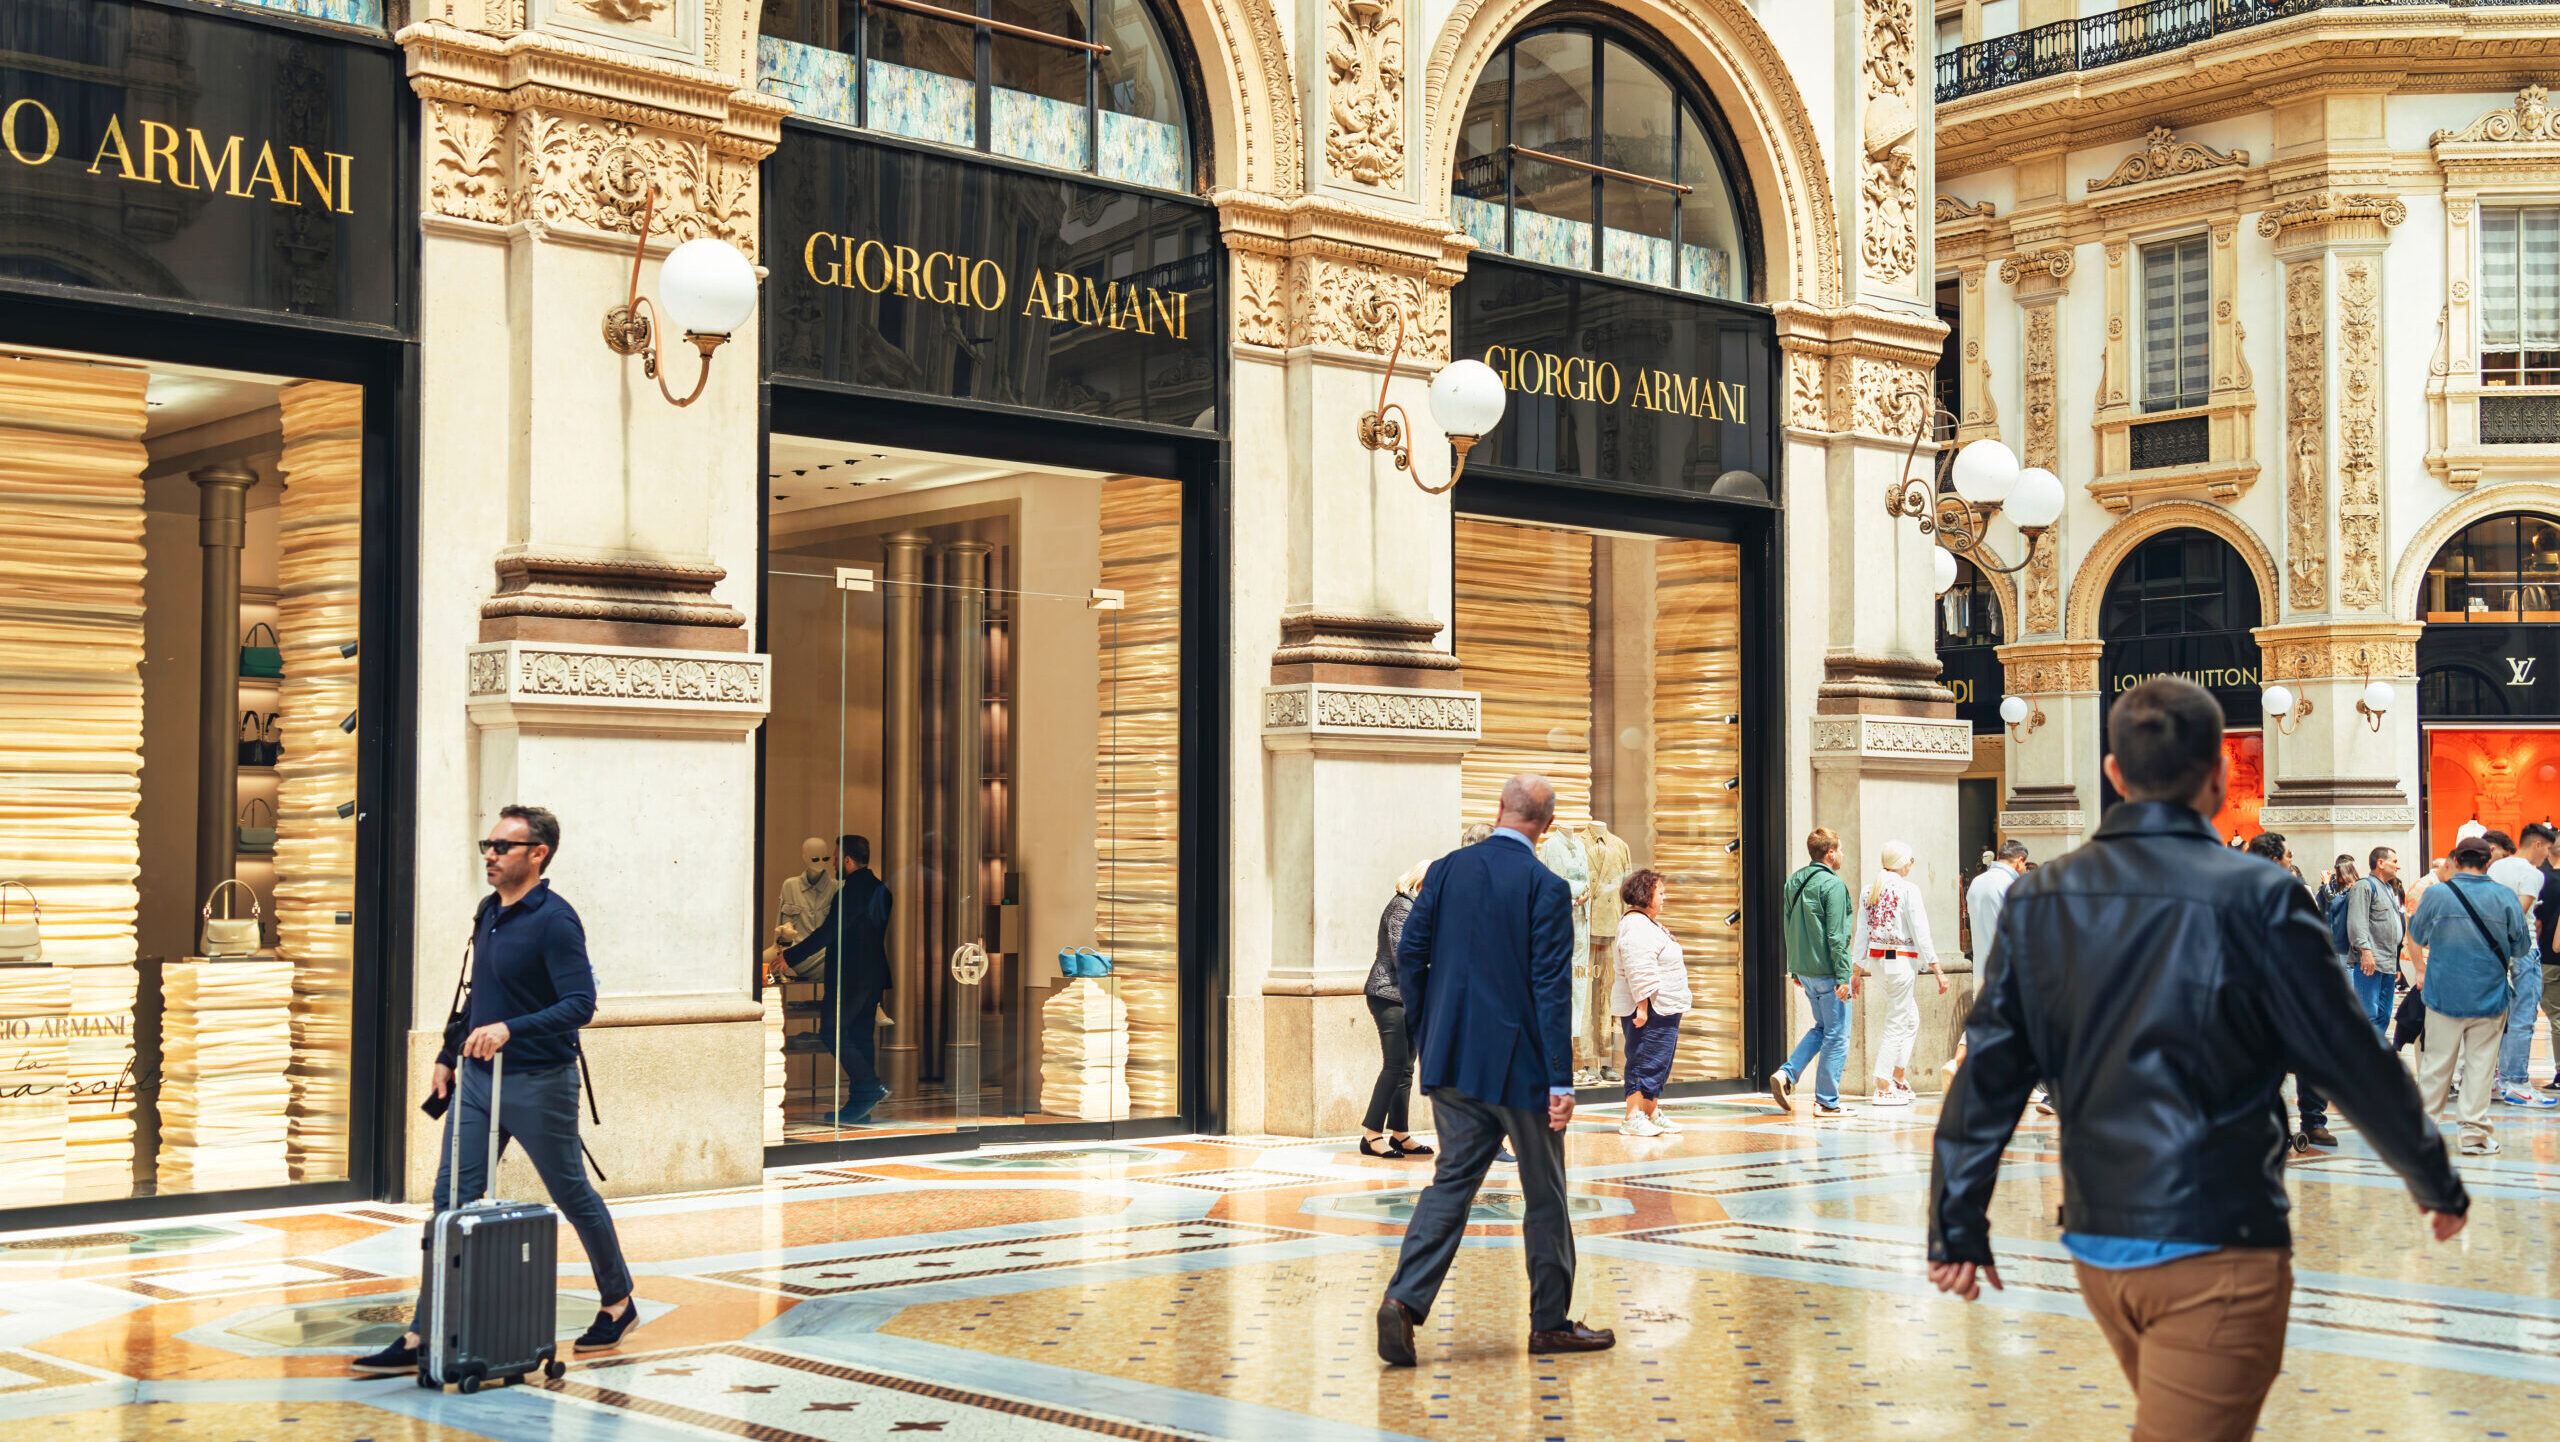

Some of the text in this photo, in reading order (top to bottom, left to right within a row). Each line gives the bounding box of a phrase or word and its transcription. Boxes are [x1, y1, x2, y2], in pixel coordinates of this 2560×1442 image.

[87, 113, 354, 214] ARMANI
[804, 231, 1188, 340] GIORGIO ARMANI
[1484, 345, 1746, 424] GIORGIO ARMANI
[39, 1016, 126, 1038] ARMANI
